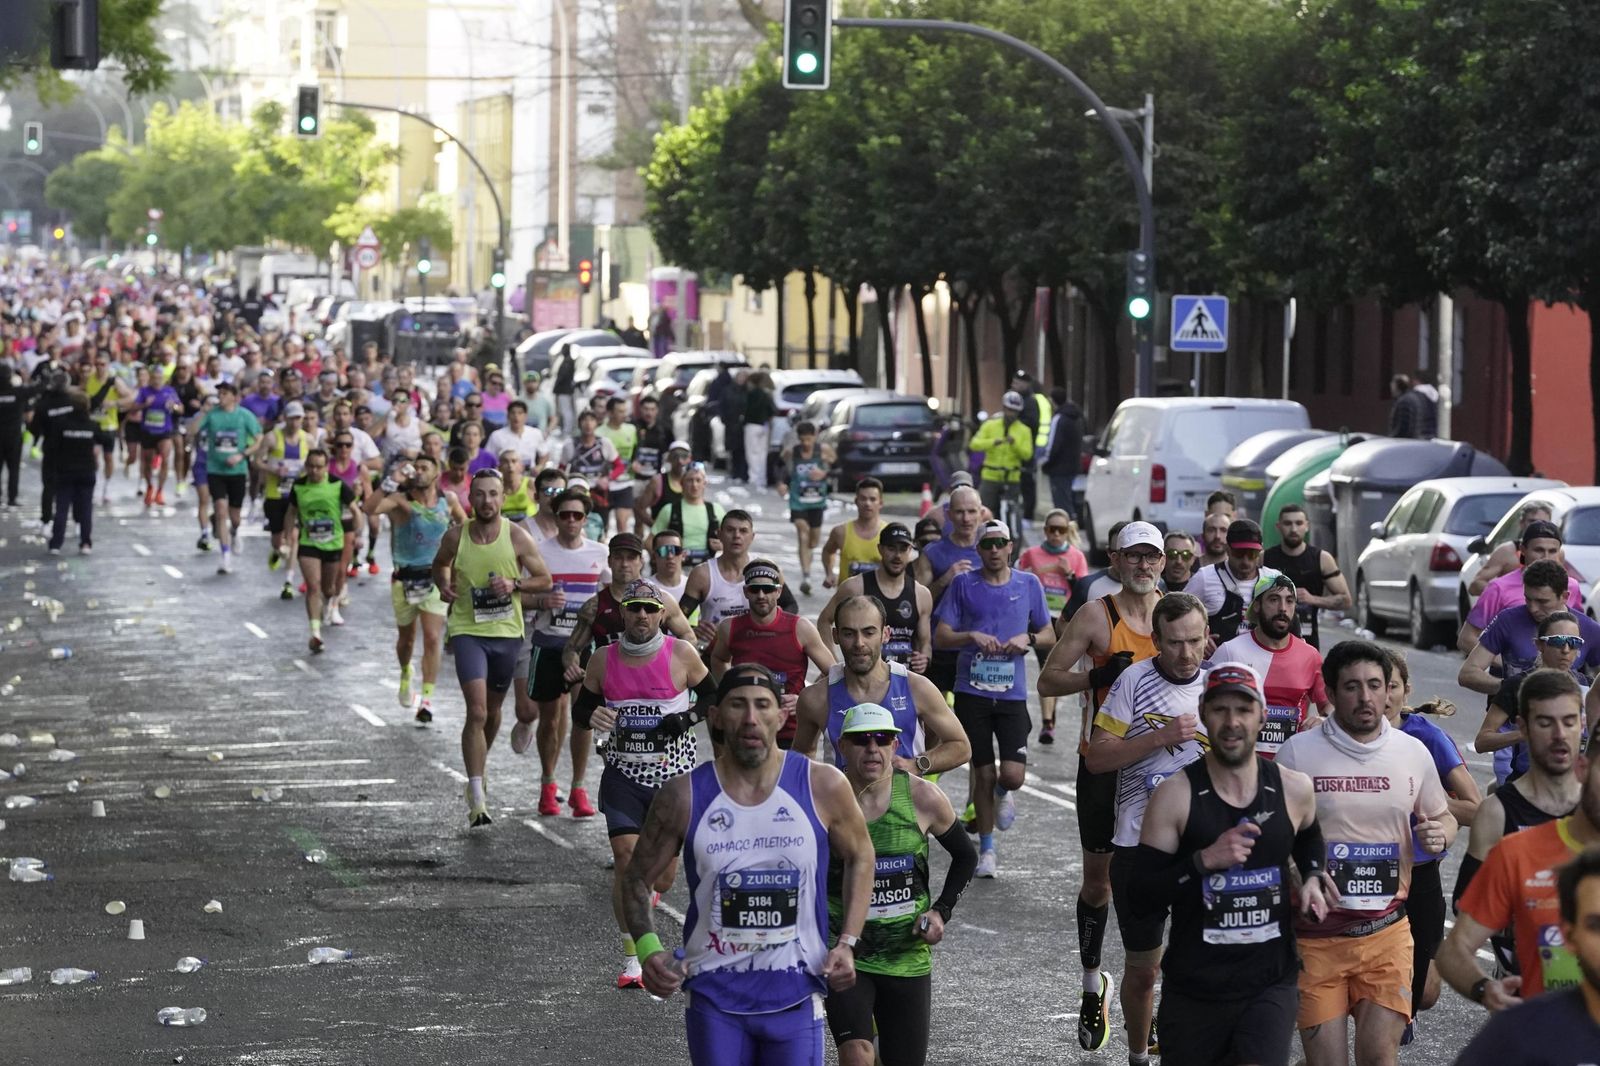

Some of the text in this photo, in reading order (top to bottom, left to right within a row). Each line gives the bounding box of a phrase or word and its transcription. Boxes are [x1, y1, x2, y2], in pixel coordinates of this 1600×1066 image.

[971, 673, 1014, 683] DEL CERRO
[1260, 731, 1285, 743] TOMI
[624, 741, 655, 752] PABLO
[753, 836, 804, 848] ATLETISMO
[1354, 847, 1392, 856] ZURICH
[875, 859, 907, 870] URICH
[1354, 866, 1376, 876] 4640
[746, 874, 791, 885] ZURICH
[1231, 871, 1273, 886] ZURICH
[1347, 879, 1383, 894] GREG
[748, 896, 772, 907] 5184
[1233, 896, 1257, 908] 3798
[739, 911, 782, 926] FABIO
[1219, 908, 1270, 928] JULIEN
